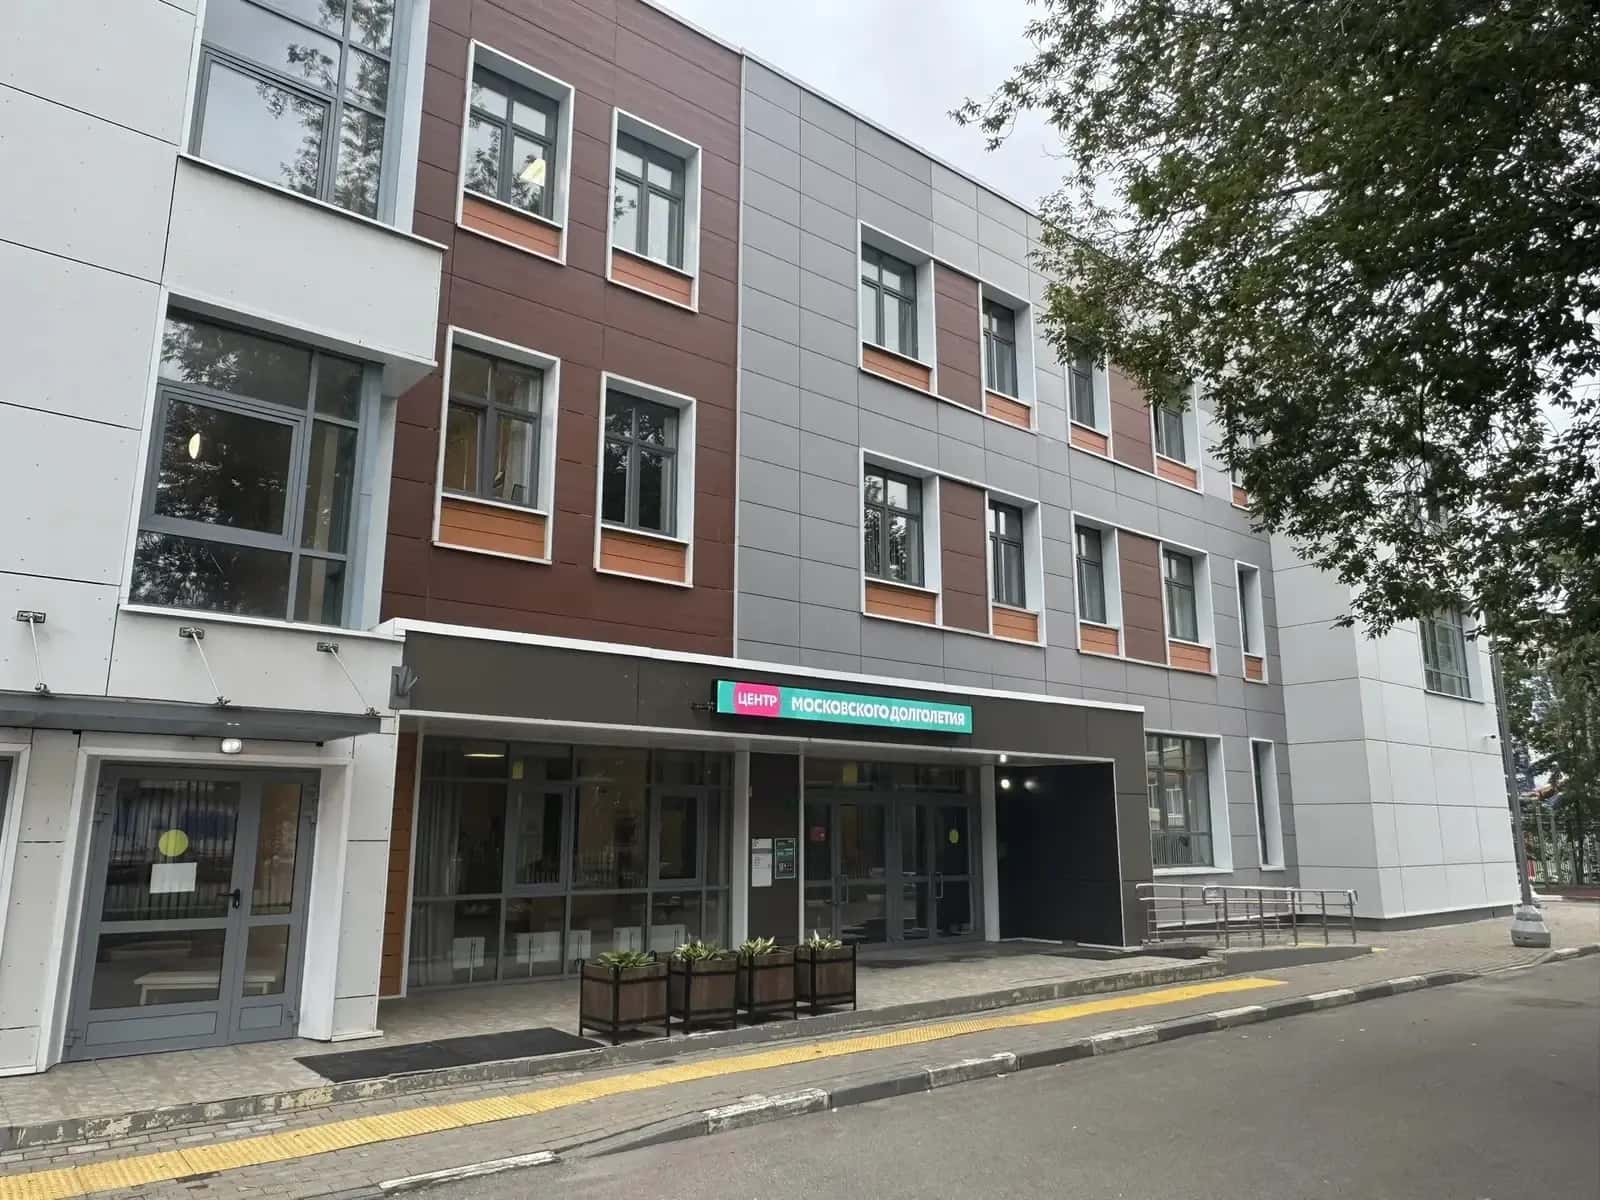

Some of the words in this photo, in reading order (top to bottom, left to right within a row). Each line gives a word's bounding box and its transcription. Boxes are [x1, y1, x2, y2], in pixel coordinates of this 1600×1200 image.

[738, 691, 777, 708] ЦЕНТР
[791, 696, 889, 719] МОСКОВСКОГО
[889, 705, 966, 726] ДОЛГОЛЕТИЯ
